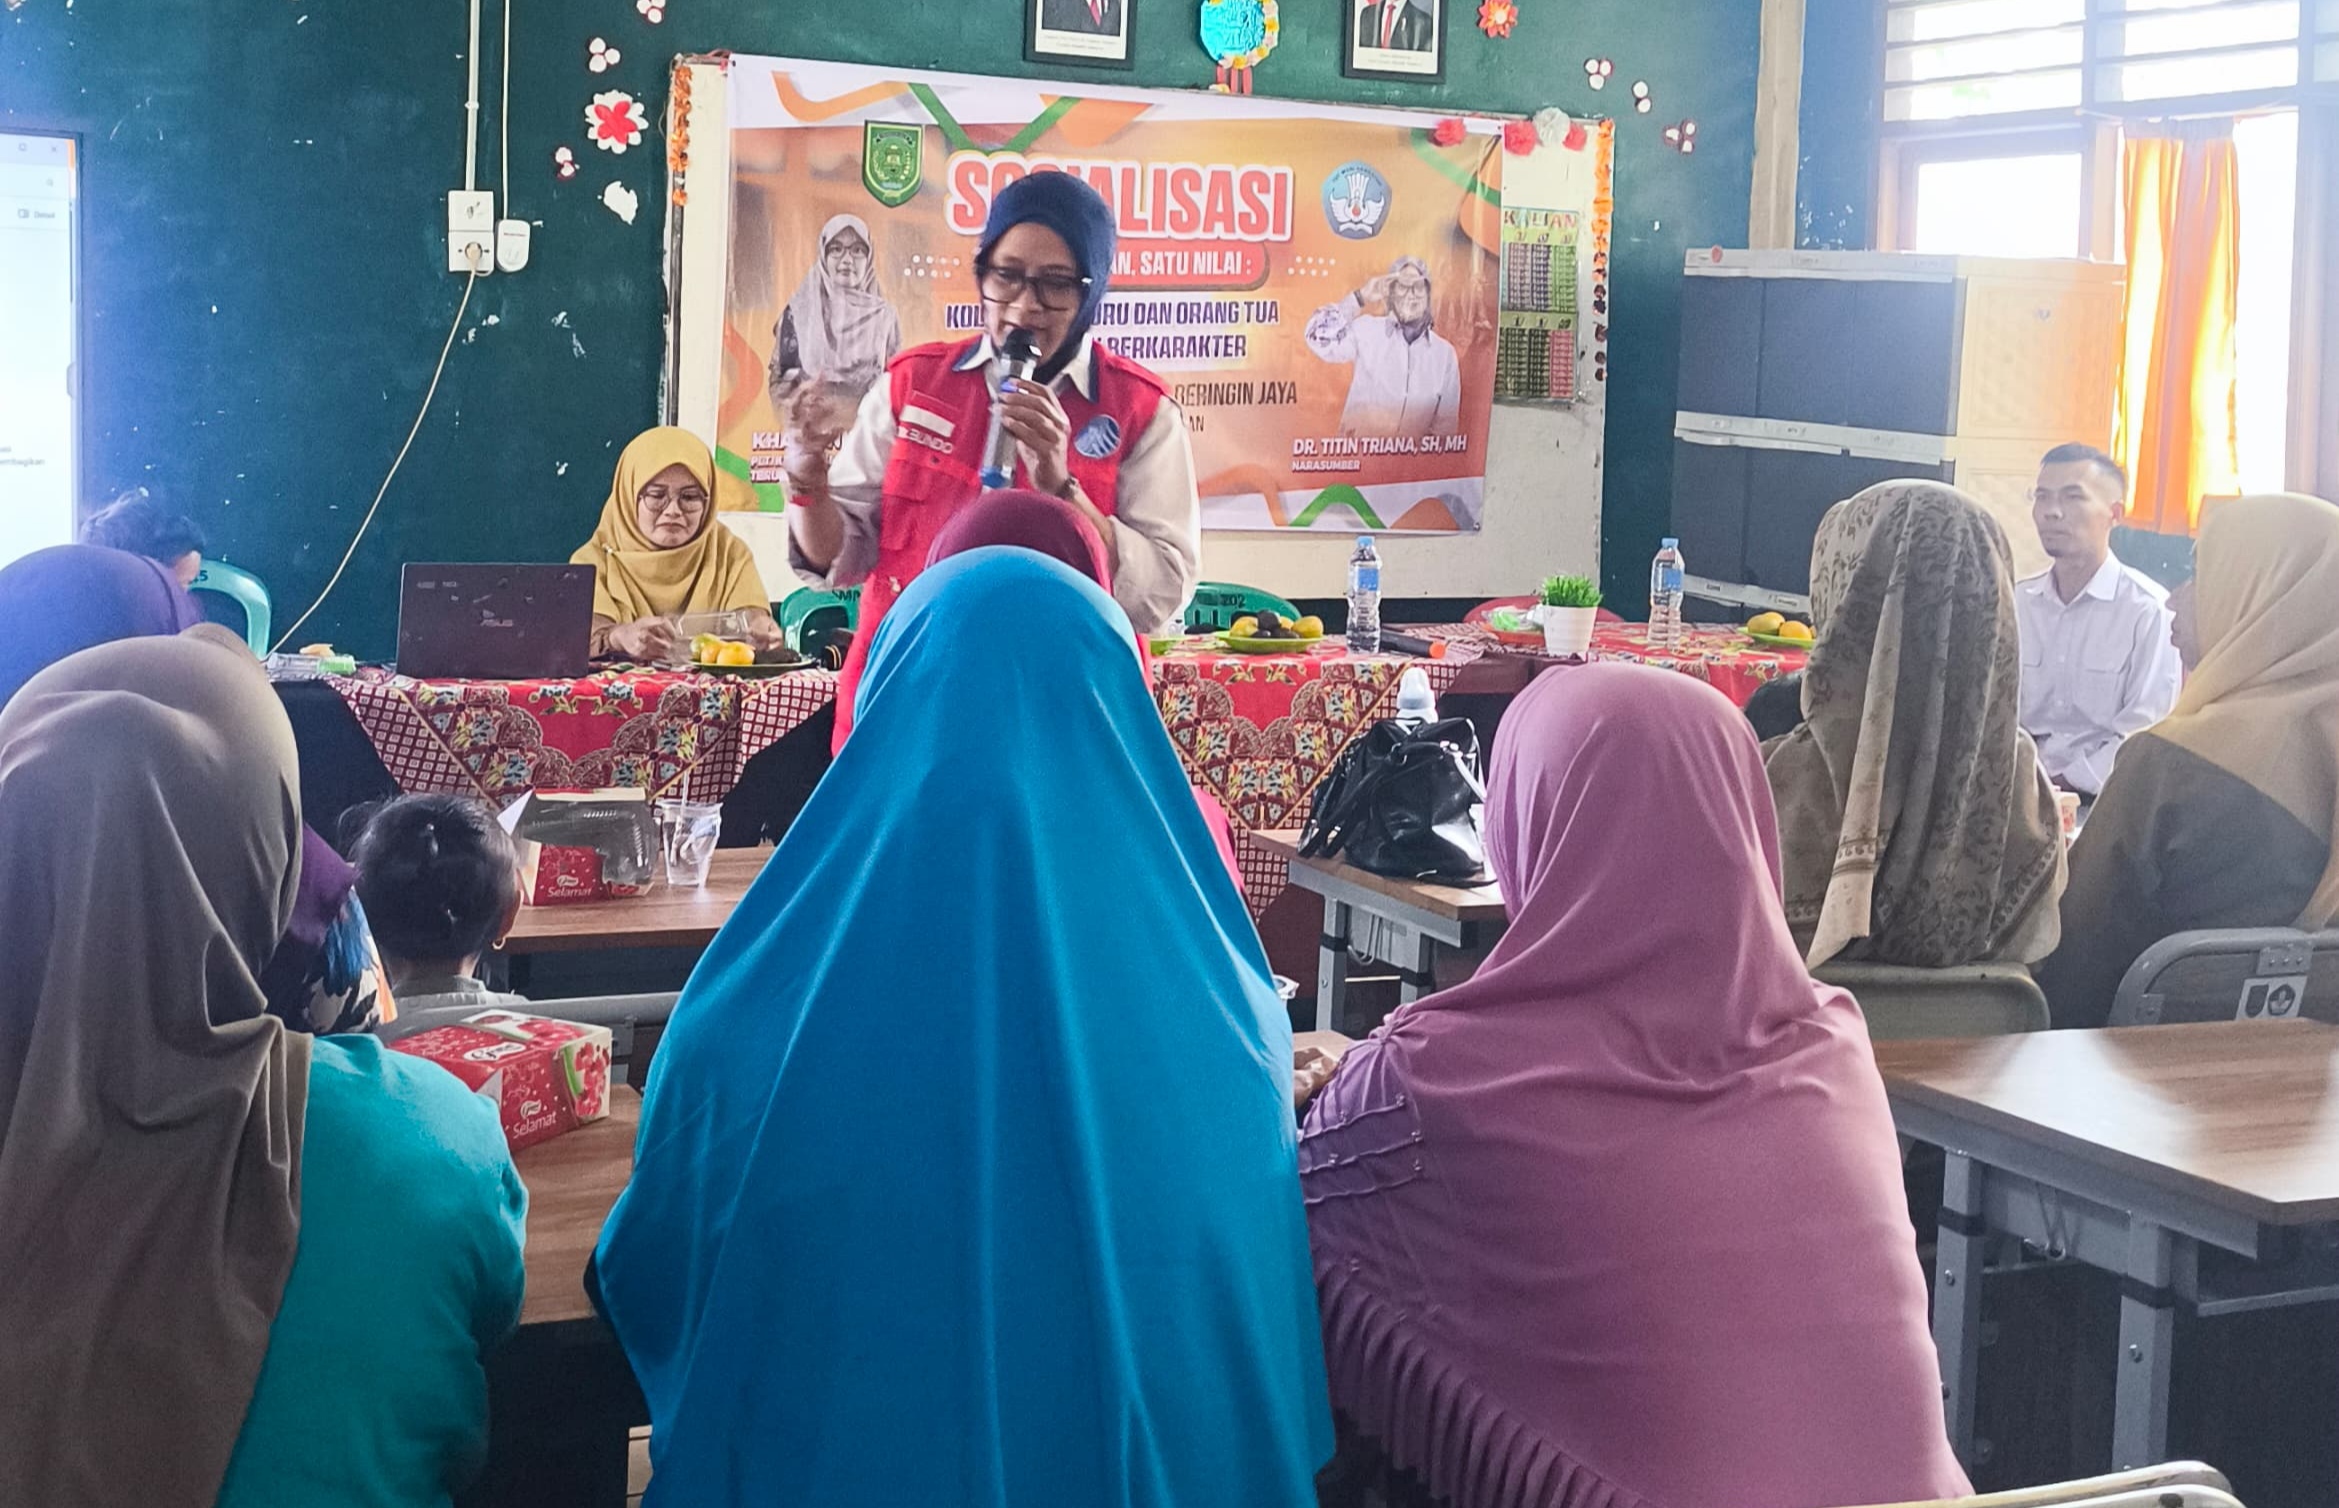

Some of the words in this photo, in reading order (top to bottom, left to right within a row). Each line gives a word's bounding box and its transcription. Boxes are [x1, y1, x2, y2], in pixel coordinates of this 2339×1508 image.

[952, 161, 1289, 236] SLISASI
[1140, 251, 1189, 276] SATU
[1192, 251, 1242, 275] NILAI
[1134, 302, 1172, 325] DAN
[1176, 301, 1240, 324] ORANG
[1244, 300, 1279, 323] TUA
[1107, 335, 1247, 359] BERKARAKTER
[1174, 382, 1254, 406] BERINGIN
[1257, 381, 1297, 405] JAYA
[1293, 437, 1318, 456] DR.
[1321, 437, 1358, 454] TITIN
[1361, 435, 1418, 455] TRIANA,
[1420, 434, 1442, 453] SH,
[1444, 433, 1468, 451] MH
[1291, 460, 1360, 472] NARASUMBER
[546, 885, 593, 898] Selamat
[512, 1111, 557, 1140] Selamat
